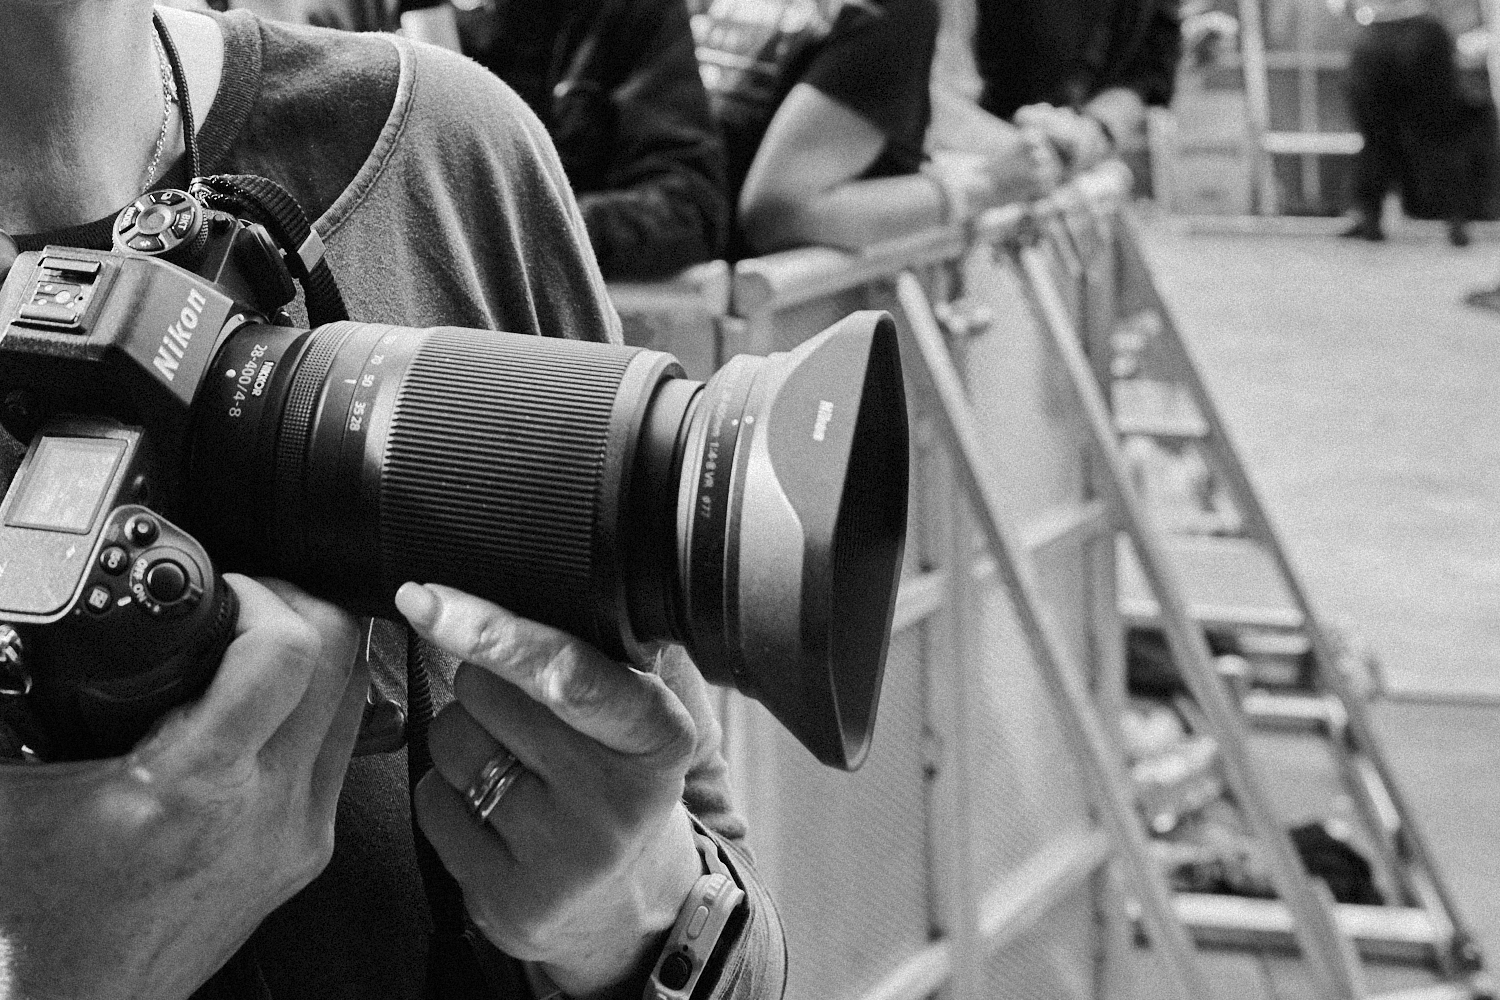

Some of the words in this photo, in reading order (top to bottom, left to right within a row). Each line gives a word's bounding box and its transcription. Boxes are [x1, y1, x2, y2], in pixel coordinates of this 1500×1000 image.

[178, 213, 191, 231] BKT
[152, 287, 206, 382] Nikon
[251, 360, 275, 397] NIKKOR
[361, 374, 375, 388] 50
[353, 400, 367, 416] 35
[349, 415, 363, 432] 28
